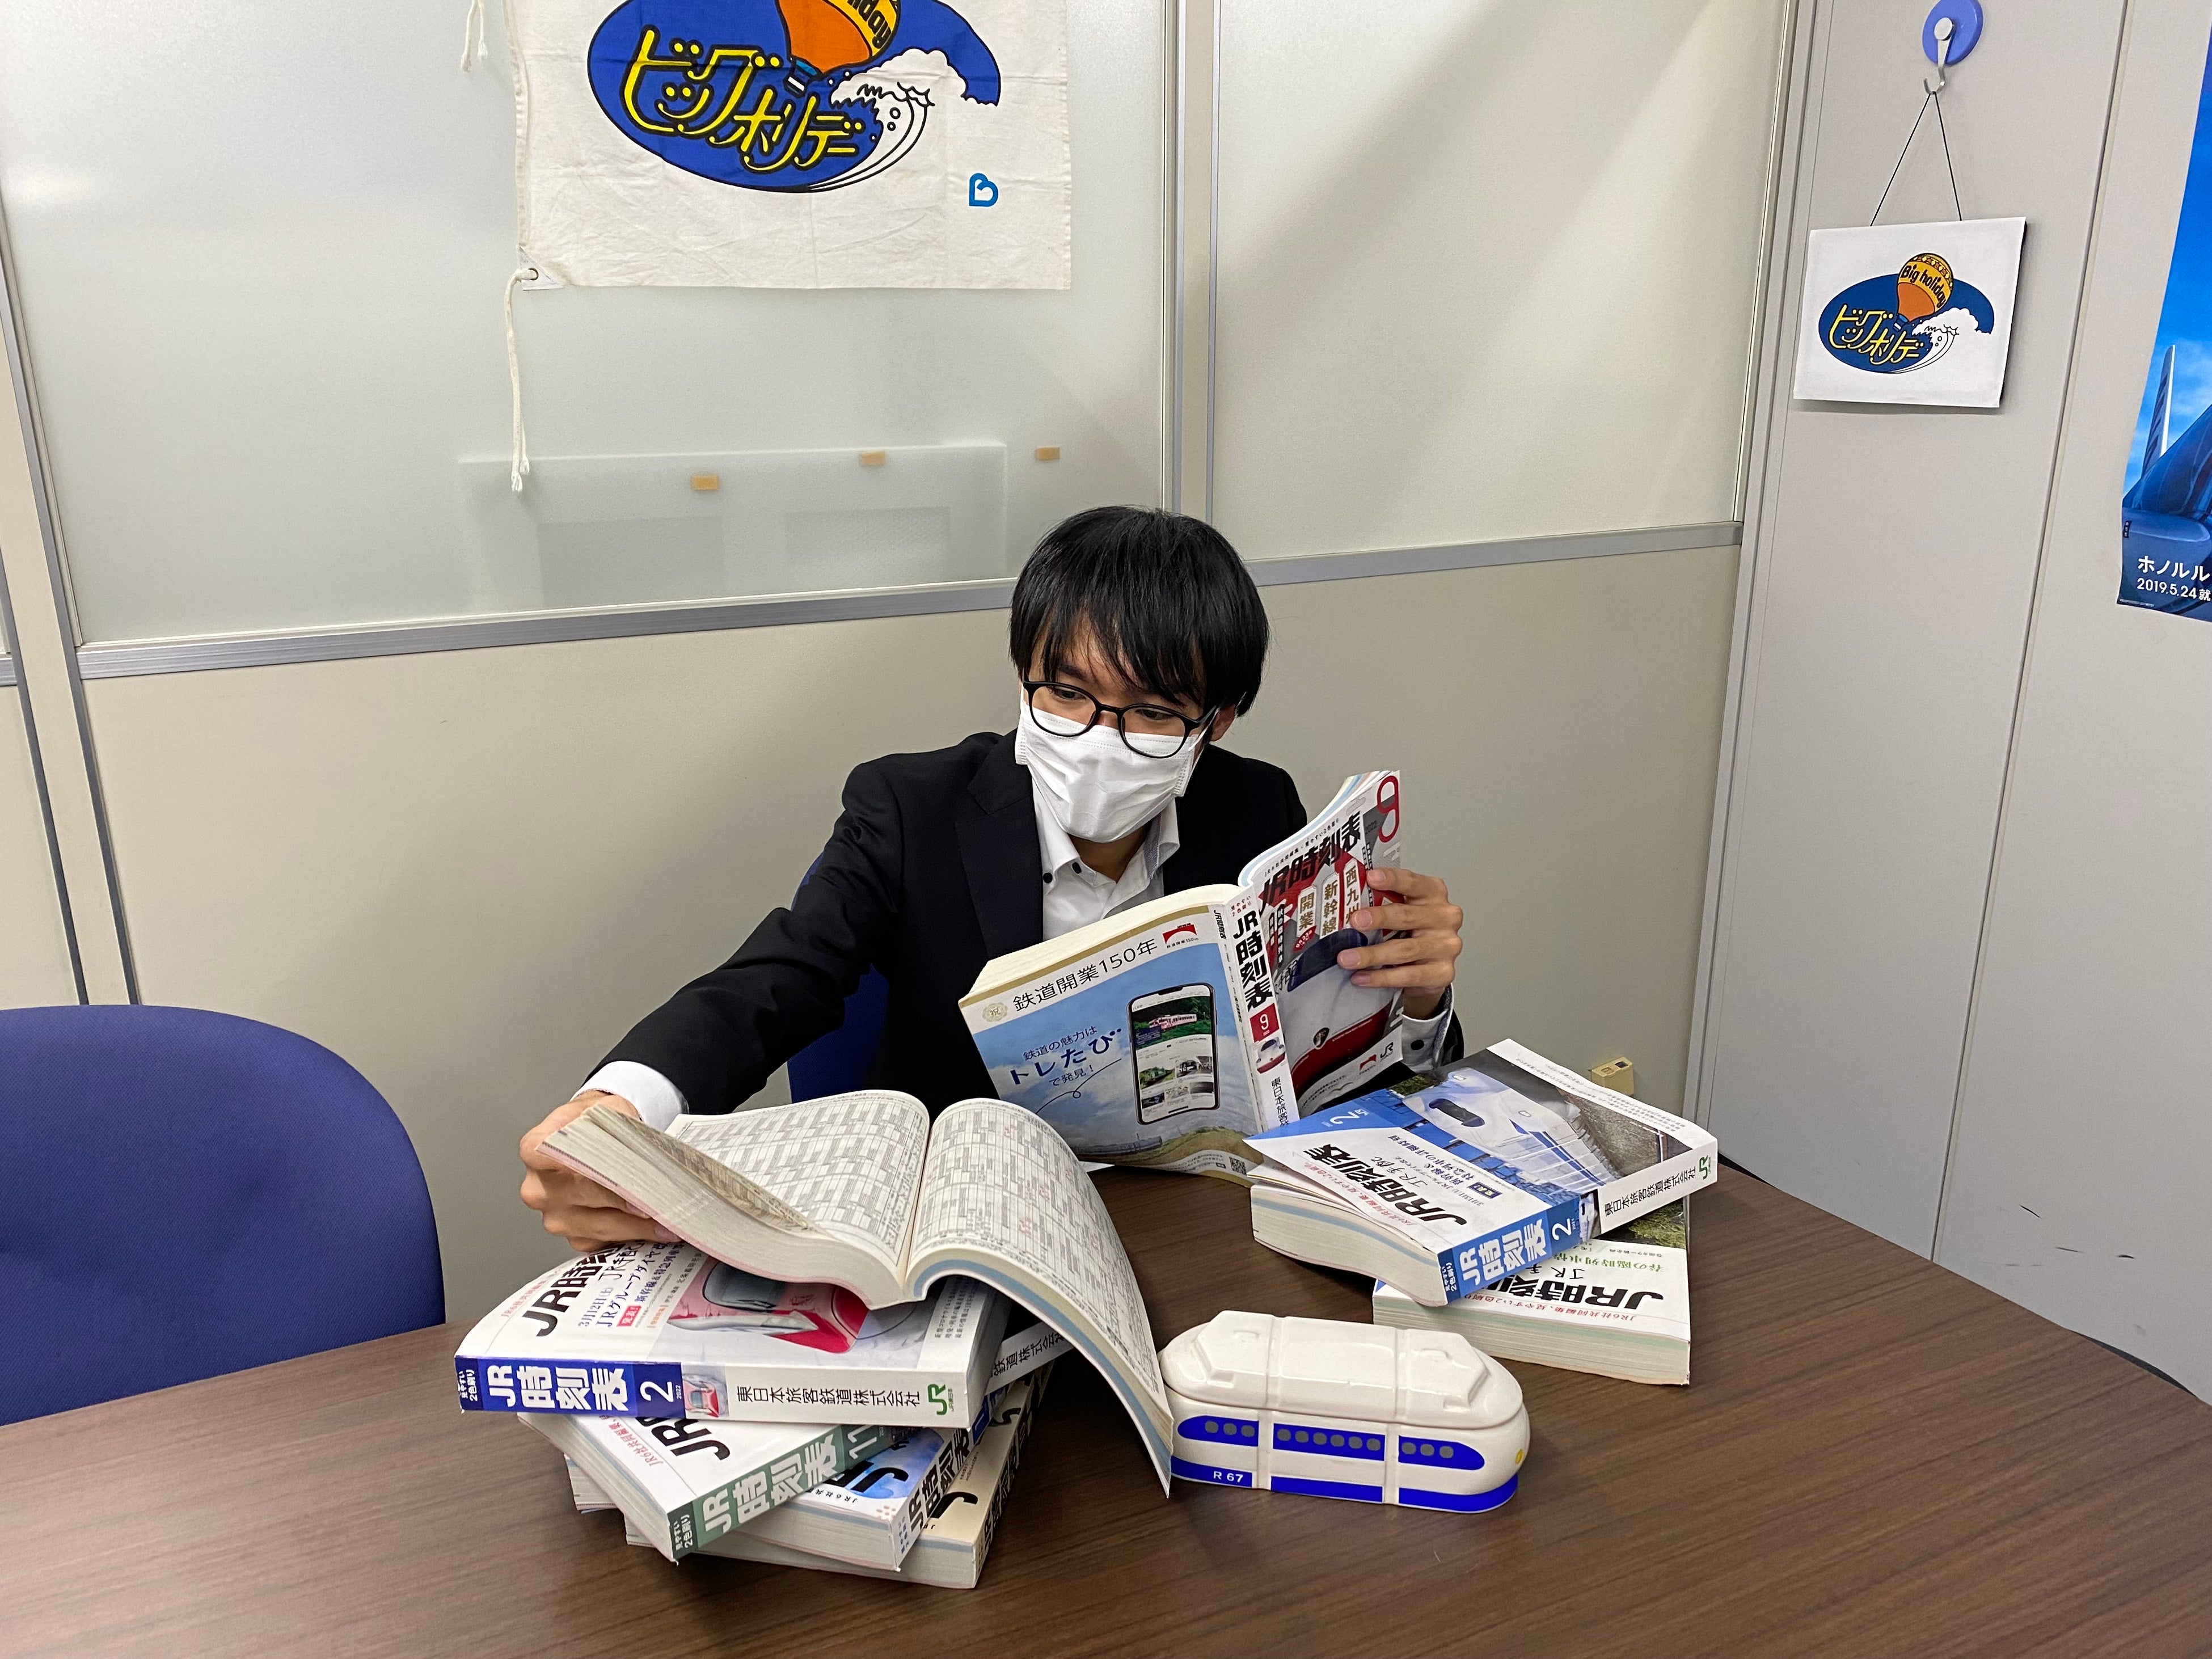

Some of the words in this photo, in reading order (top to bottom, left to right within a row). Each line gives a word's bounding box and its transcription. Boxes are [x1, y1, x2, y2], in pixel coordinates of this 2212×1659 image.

[1900, 264, 1920, 284] Big
[1919, 269, 1947, 309] holiday
[2137, 555, 2210, 582] ホノルル
[1377, 775, 1400, 843] 9
[1299, 892, 1315, 931] 開業
[1322, 880, 1339, 937] 新幹線
[1012, 938, 1158, 1012] 鉄道開業150年
[1232, 910, 1273, 1012] JR時刻表
[1023, 1025, 1097, 1061] 鉄道の魅力は
[1259, 1013, 1269, 1031] 9
[1010, 1028, 1122, 1085] トレたび
[1380, 1042, 1394, 1058] JR
[1303, 1143, 1468, 1226] JR時刻表
[1699, 1155, 1709, 1180] JR
[1604, 1166, 1696, 1217] 東日本旅客鉄道株式会社
[1551, 1218, 1572, 1241] 2
[1459, 1218, 1547, 1286] JR時刻表
[466, 1369, 478, 1402] 2色刷り
[487, 1365, 629, 1412] JR時刻表
[639, 1380, 675, 1403] 2
[736, 1385, 922, 1408] 東日本旅客鉄道株式会社
[927, 1383, 947, 1416] JR
[635, 1418, 731, 1460] JR
[702, 1433, 838, 1534] JR時刻表
[908, 1428, 970, 1533] JR時刻表
[1213, 1470, 1222, 1480] R
[1226, 1472, 1244, 1483] 67
